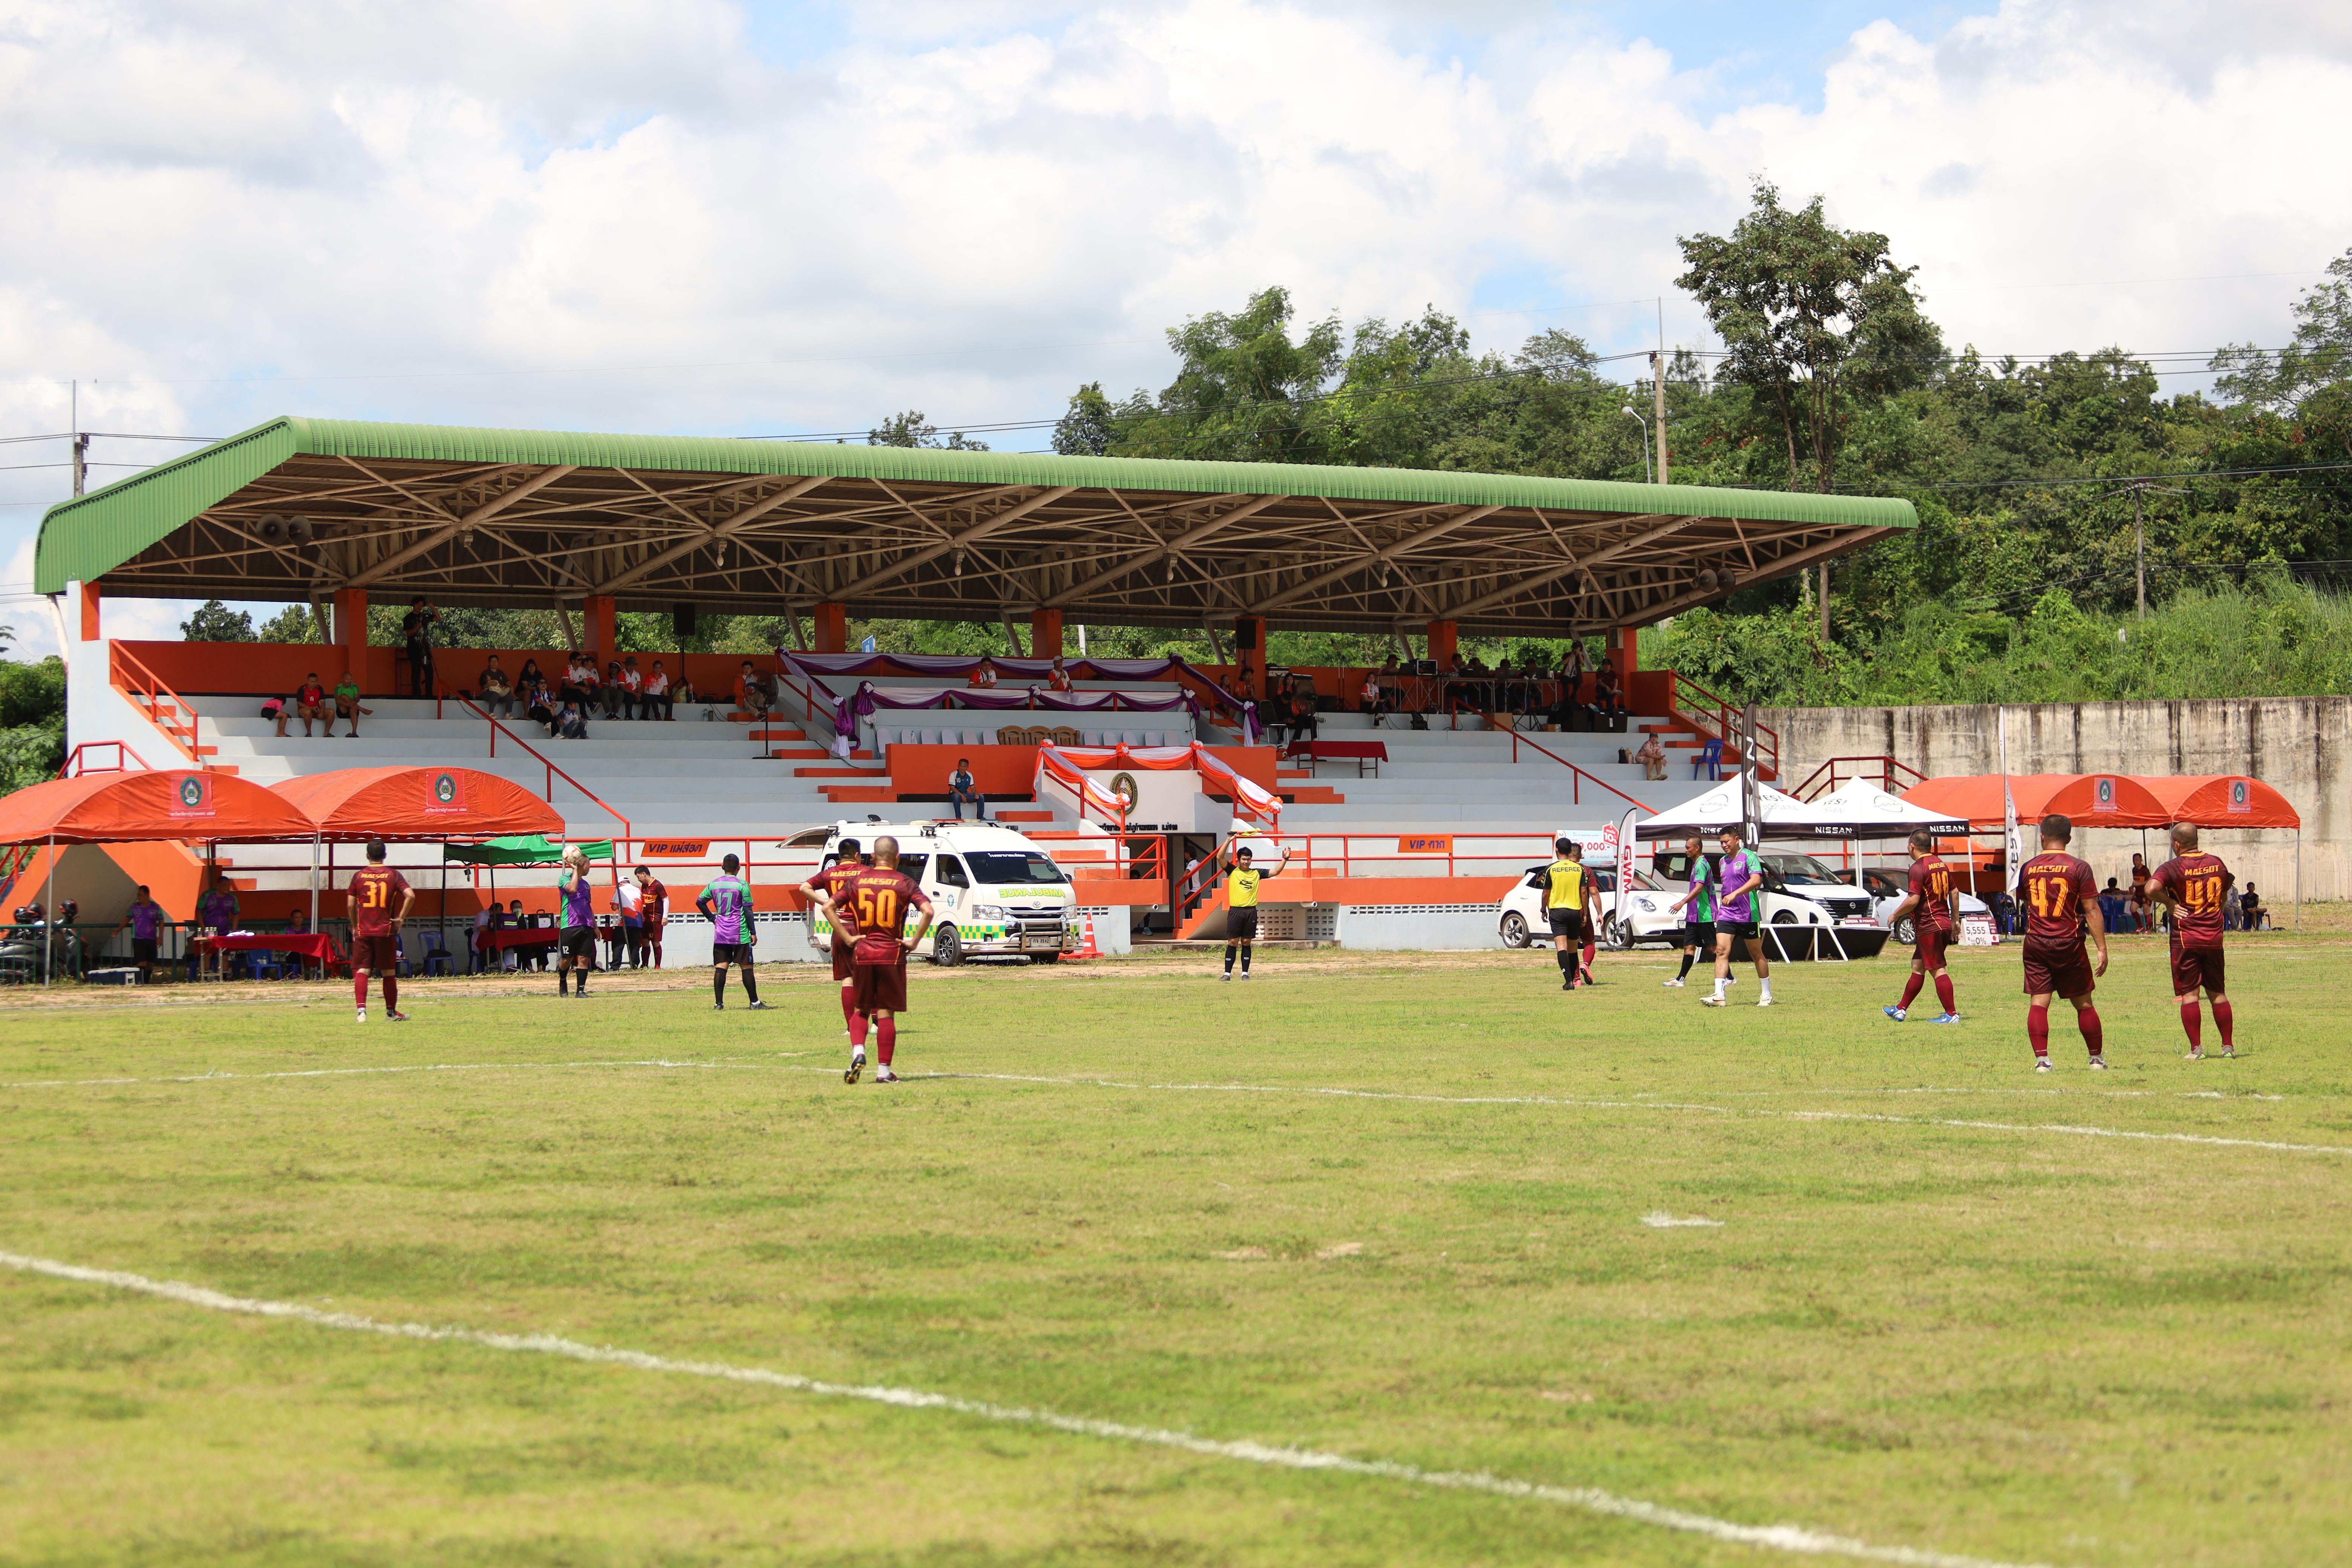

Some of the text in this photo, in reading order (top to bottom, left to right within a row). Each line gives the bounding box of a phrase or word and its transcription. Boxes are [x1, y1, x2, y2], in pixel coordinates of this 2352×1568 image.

[649, 844, 668, 853] VIP
[1410, 840, 1425, 849] VIP
[1623, 845, 1632, 894] GWM
[2028, 865, 2069, 874] MAESOT
[2185, 865, 2219, 876] MAESOT
[858, 877, 899, 886] MAESOT
[363, 881, 387, 908] 31
[2029, 877, 2068, 917] 47
[2186, 876, 2222, 914] 49
[717, 892, 733, 915] 17
[858, 888, 897, 928] 50
[1966, 927, 1985, 935] 5,555
[562, 946, 570, 954] 12
